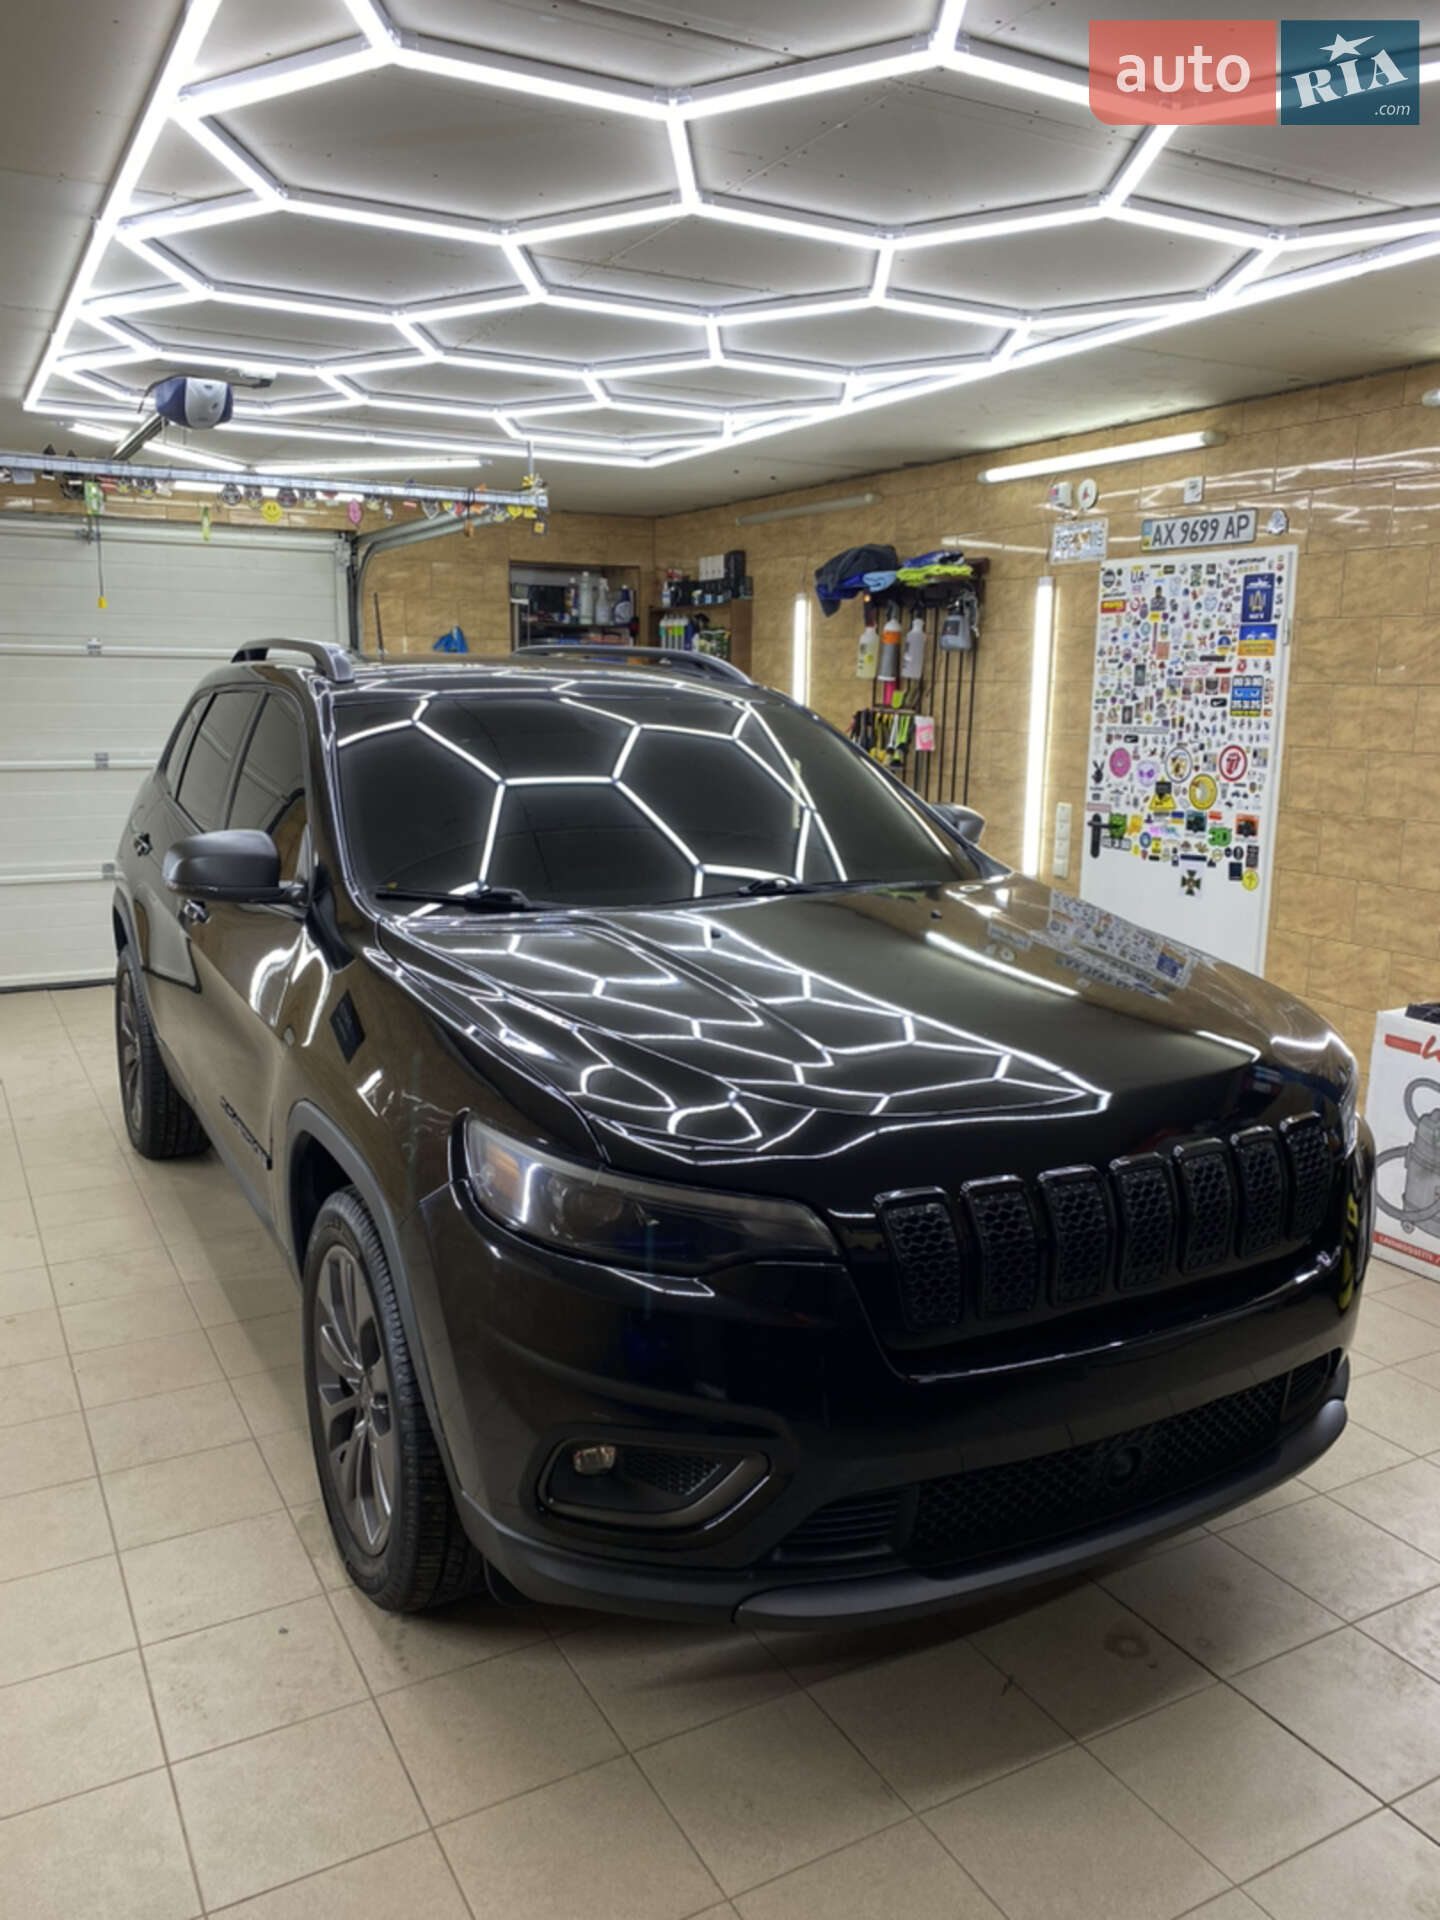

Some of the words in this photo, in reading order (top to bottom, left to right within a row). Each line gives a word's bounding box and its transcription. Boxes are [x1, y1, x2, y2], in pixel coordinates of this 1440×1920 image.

[1151, 522, 1176, 546] AX
[1180, 518, 1220, 545] 9699
[1223, 514, 1250, 540] AP
